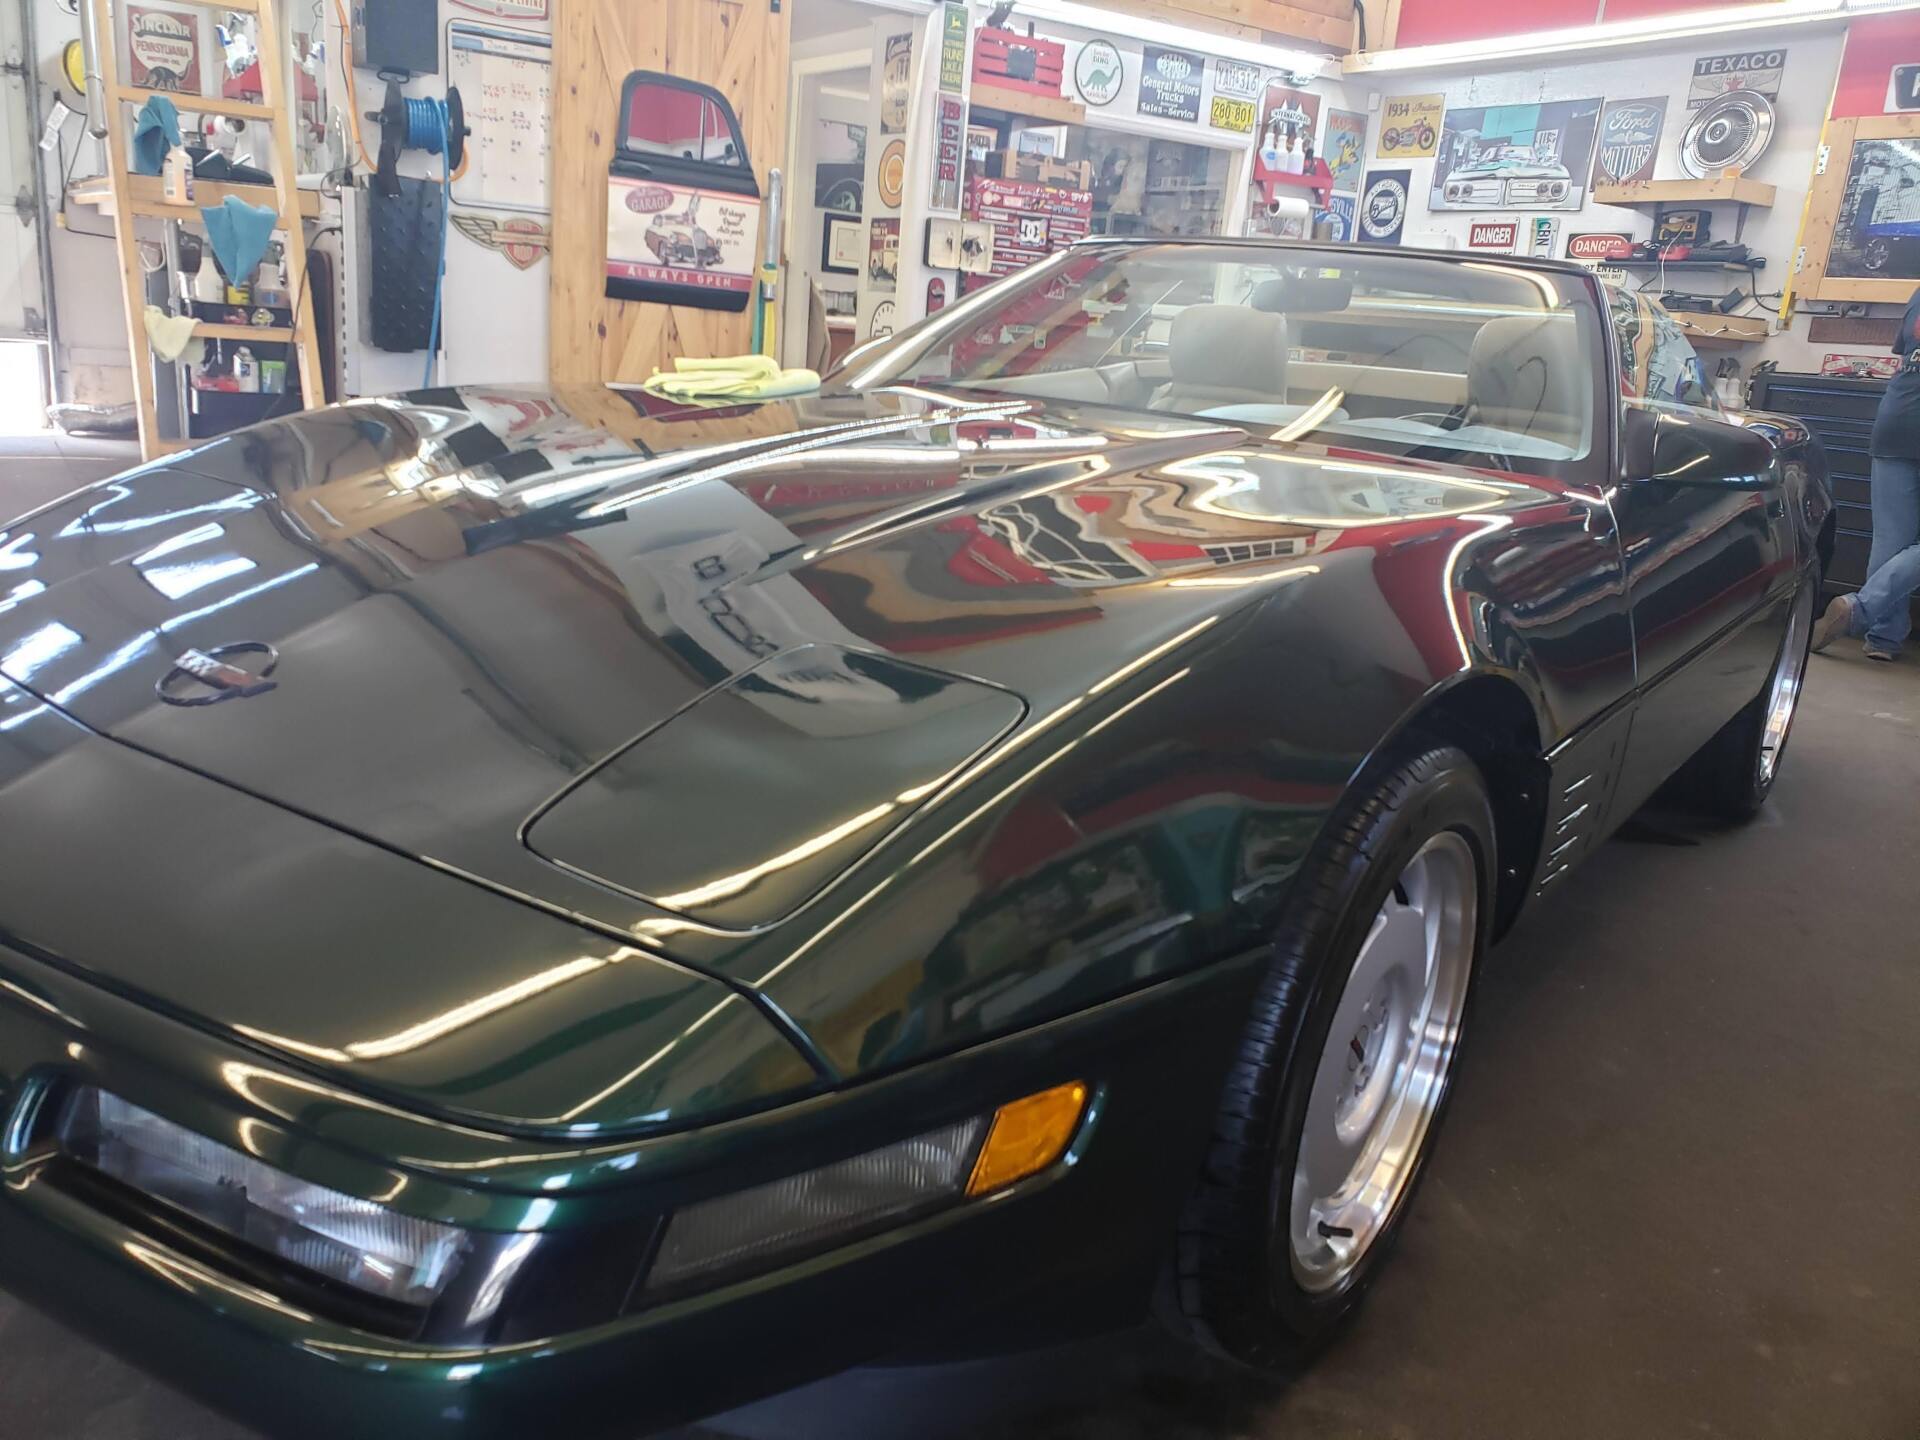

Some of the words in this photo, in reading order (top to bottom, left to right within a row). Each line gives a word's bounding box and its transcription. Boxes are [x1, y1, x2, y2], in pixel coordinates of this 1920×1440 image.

[131, 13, 192, 37] SINCLAIR
[136, 40, 190, 58] PENNSYLVANIA
[1698, 52, 1782, 74] TEXACO
[1142, 75, 1172, 92] General
[1173, 80, 1200, 97] Motors
[1156, 89, 1185, 104] Trucks
[1387, 103, 1410, 117] 1934
[1608, 108, 1657, 131] Ford
[938, 100, 961, 182] BEER
[1602, 144, 1652, 178] MOTORS
[1473, 227, 1512, 244] DANGER
[697, 274, 733, 288] OPEN
